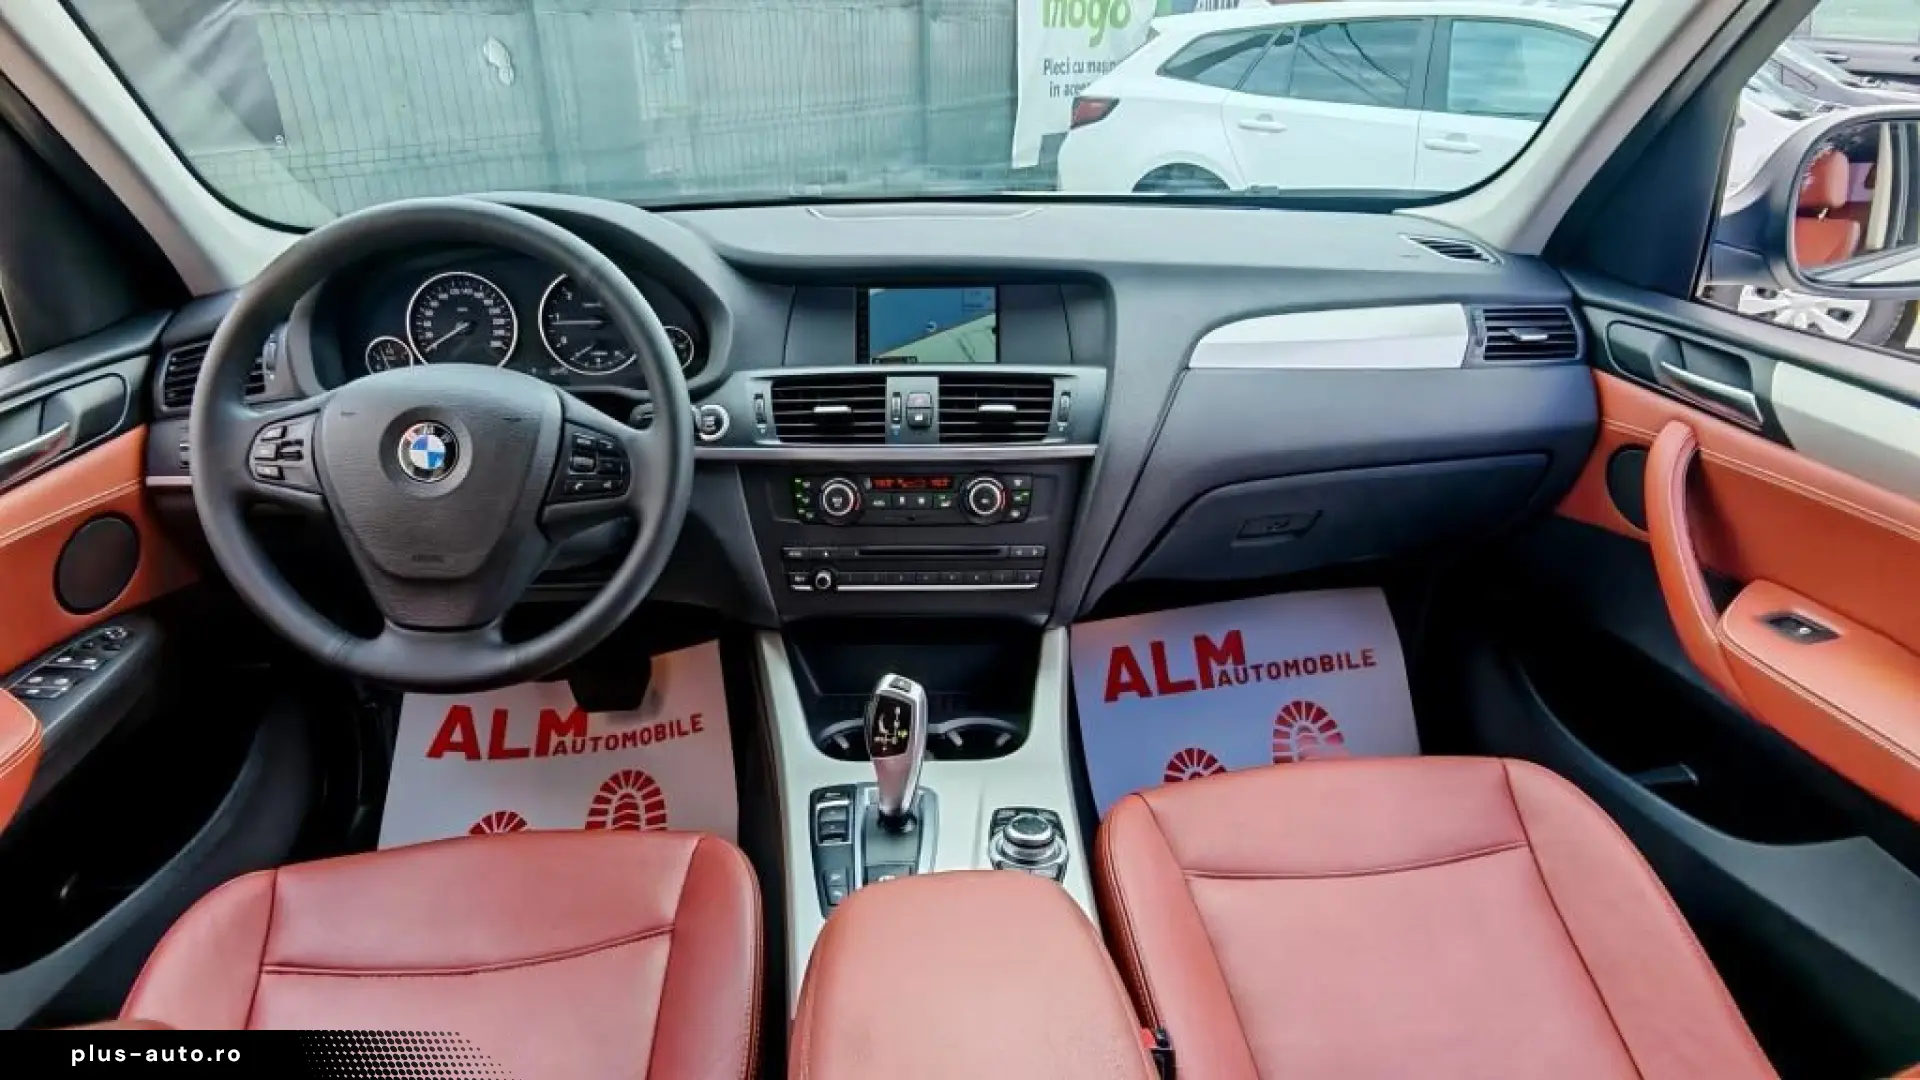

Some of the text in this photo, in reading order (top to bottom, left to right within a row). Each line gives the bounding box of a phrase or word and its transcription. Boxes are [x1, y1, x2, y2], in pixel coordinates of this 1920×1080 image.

[1042, 0, 1131, 47] mogo
[1043, 56, 1069, 75] Pleci
[1072, 61, 1084, 74] cu
[1104, 629, 1246, 703] ALM
[1217, 648, 1377, 687] AUTOMOBILE
[426, 704, 589, 760] ALM
[552, 713, 705, 756] AUTOMOBILE
